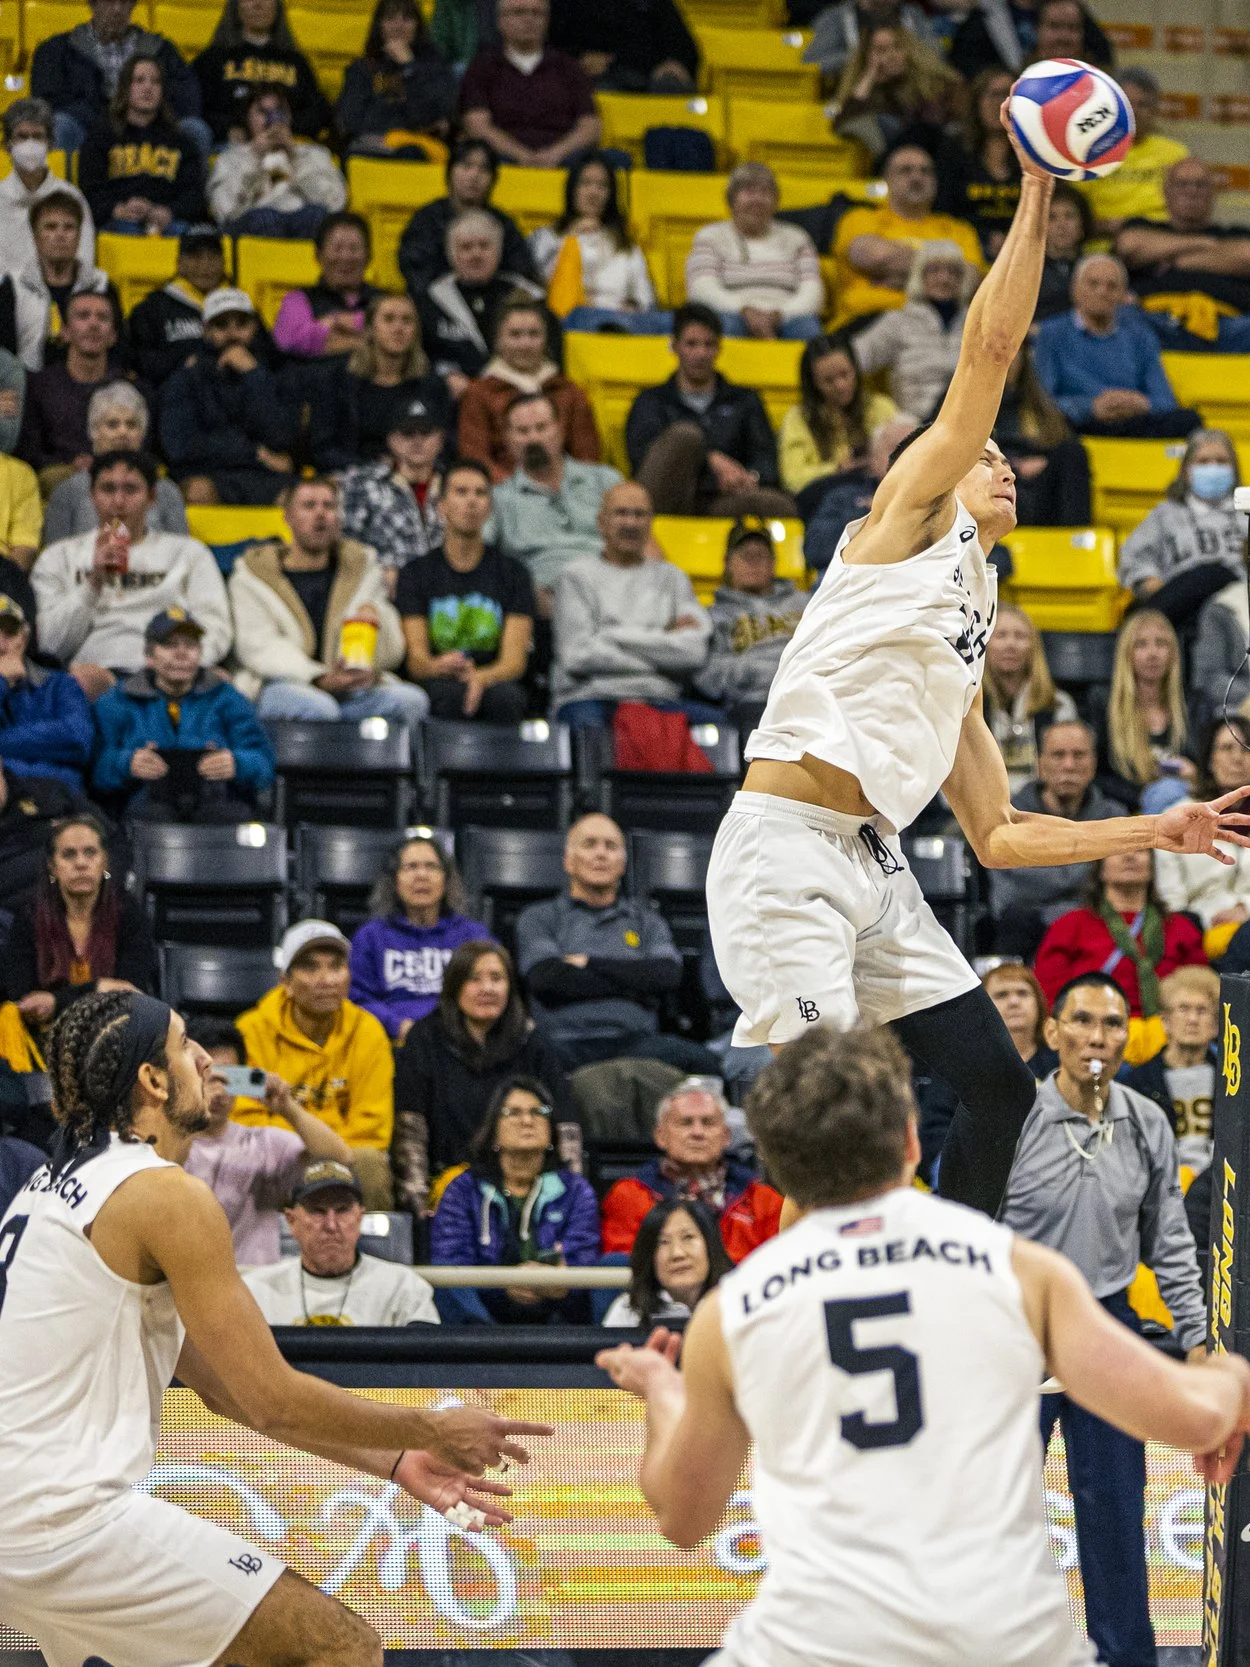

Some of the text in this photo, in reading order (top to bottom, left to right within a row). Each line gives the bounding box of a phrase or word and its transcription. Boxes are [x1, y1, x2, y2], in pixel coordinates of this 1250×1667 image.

[741, 1239, 993, 1316] LONG BEACH
[1220, 1157, 1236, 1328] LONG
[823, 1290, 925, 1453] 5
